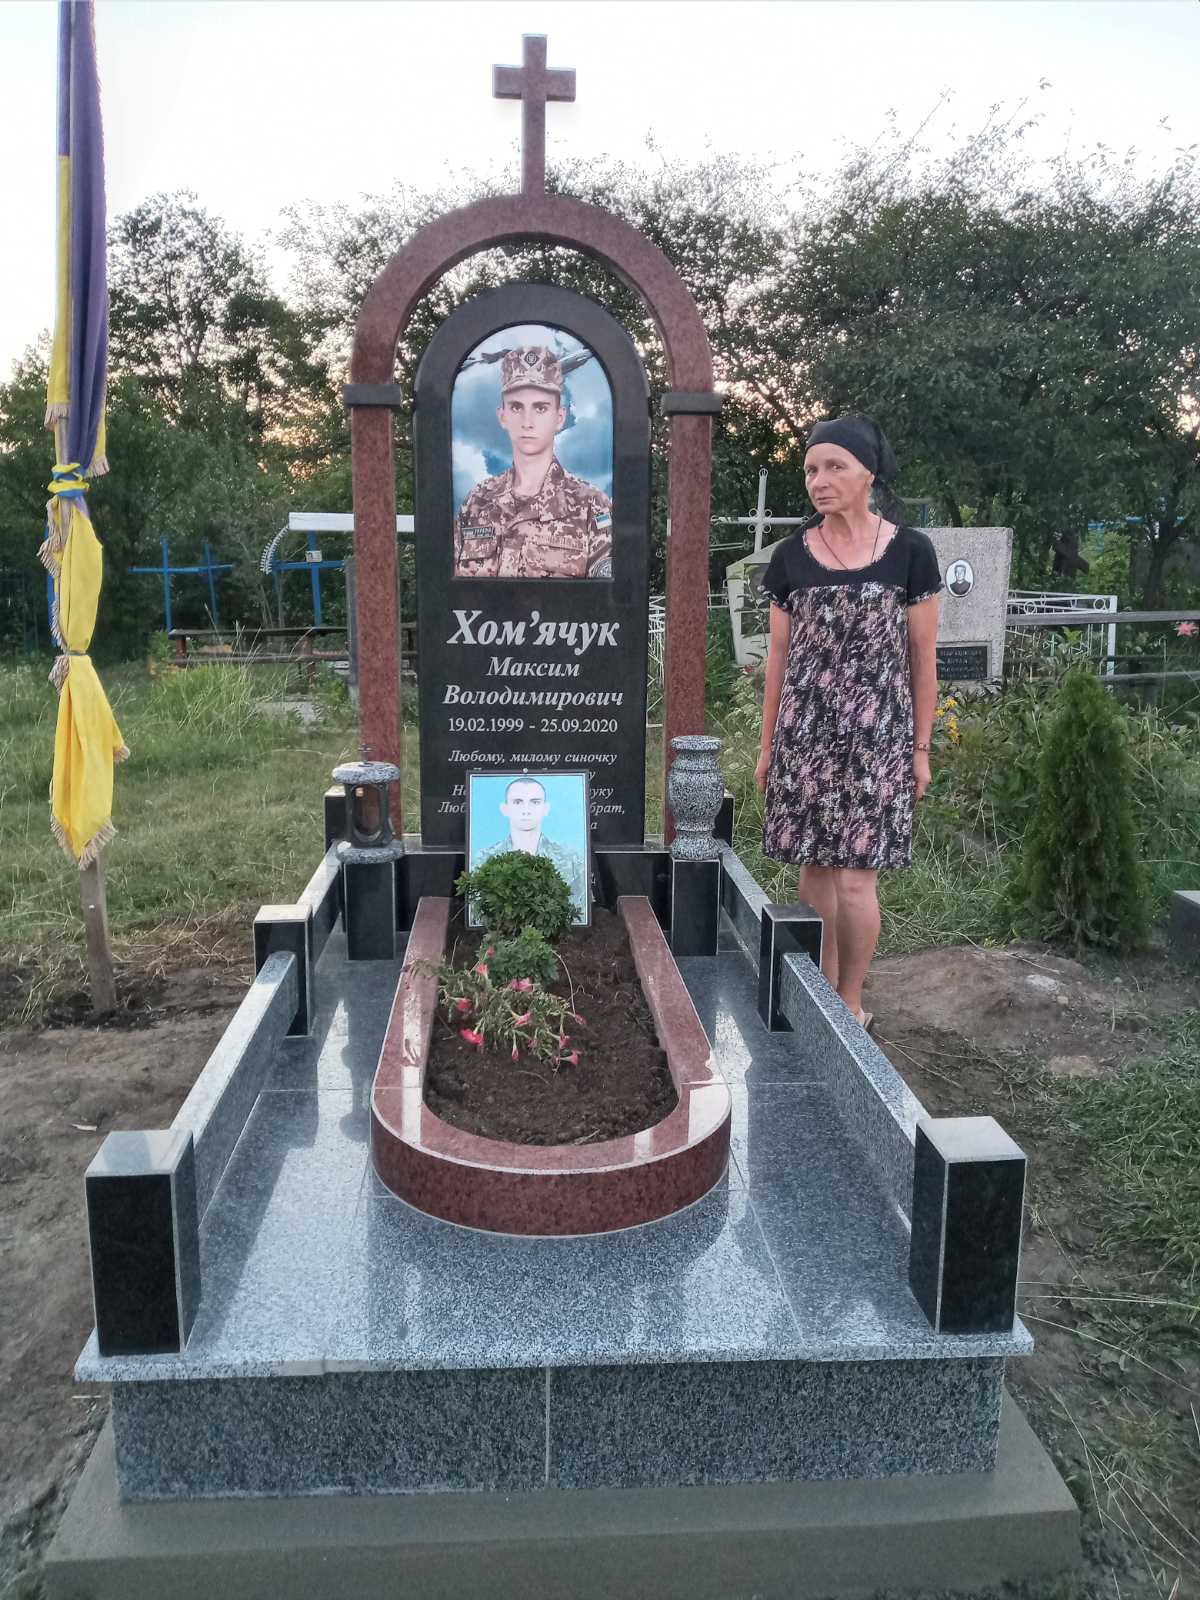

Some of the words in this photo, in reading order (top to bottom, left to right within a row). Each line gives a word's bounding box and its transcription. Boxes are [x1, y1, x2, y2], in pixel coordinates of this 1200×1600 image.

[486, 656, 580, 677] Максим
[442, 684, 624, 711] Володимирович
[448, 717, 525, 733] 19.02.1999
[541, 718, 618, 733] 25.09.2020
[448, 750, 506, 764] Любому,
[510, 753, 561, 764] милому
[564, 753, 618, 764] синочку
